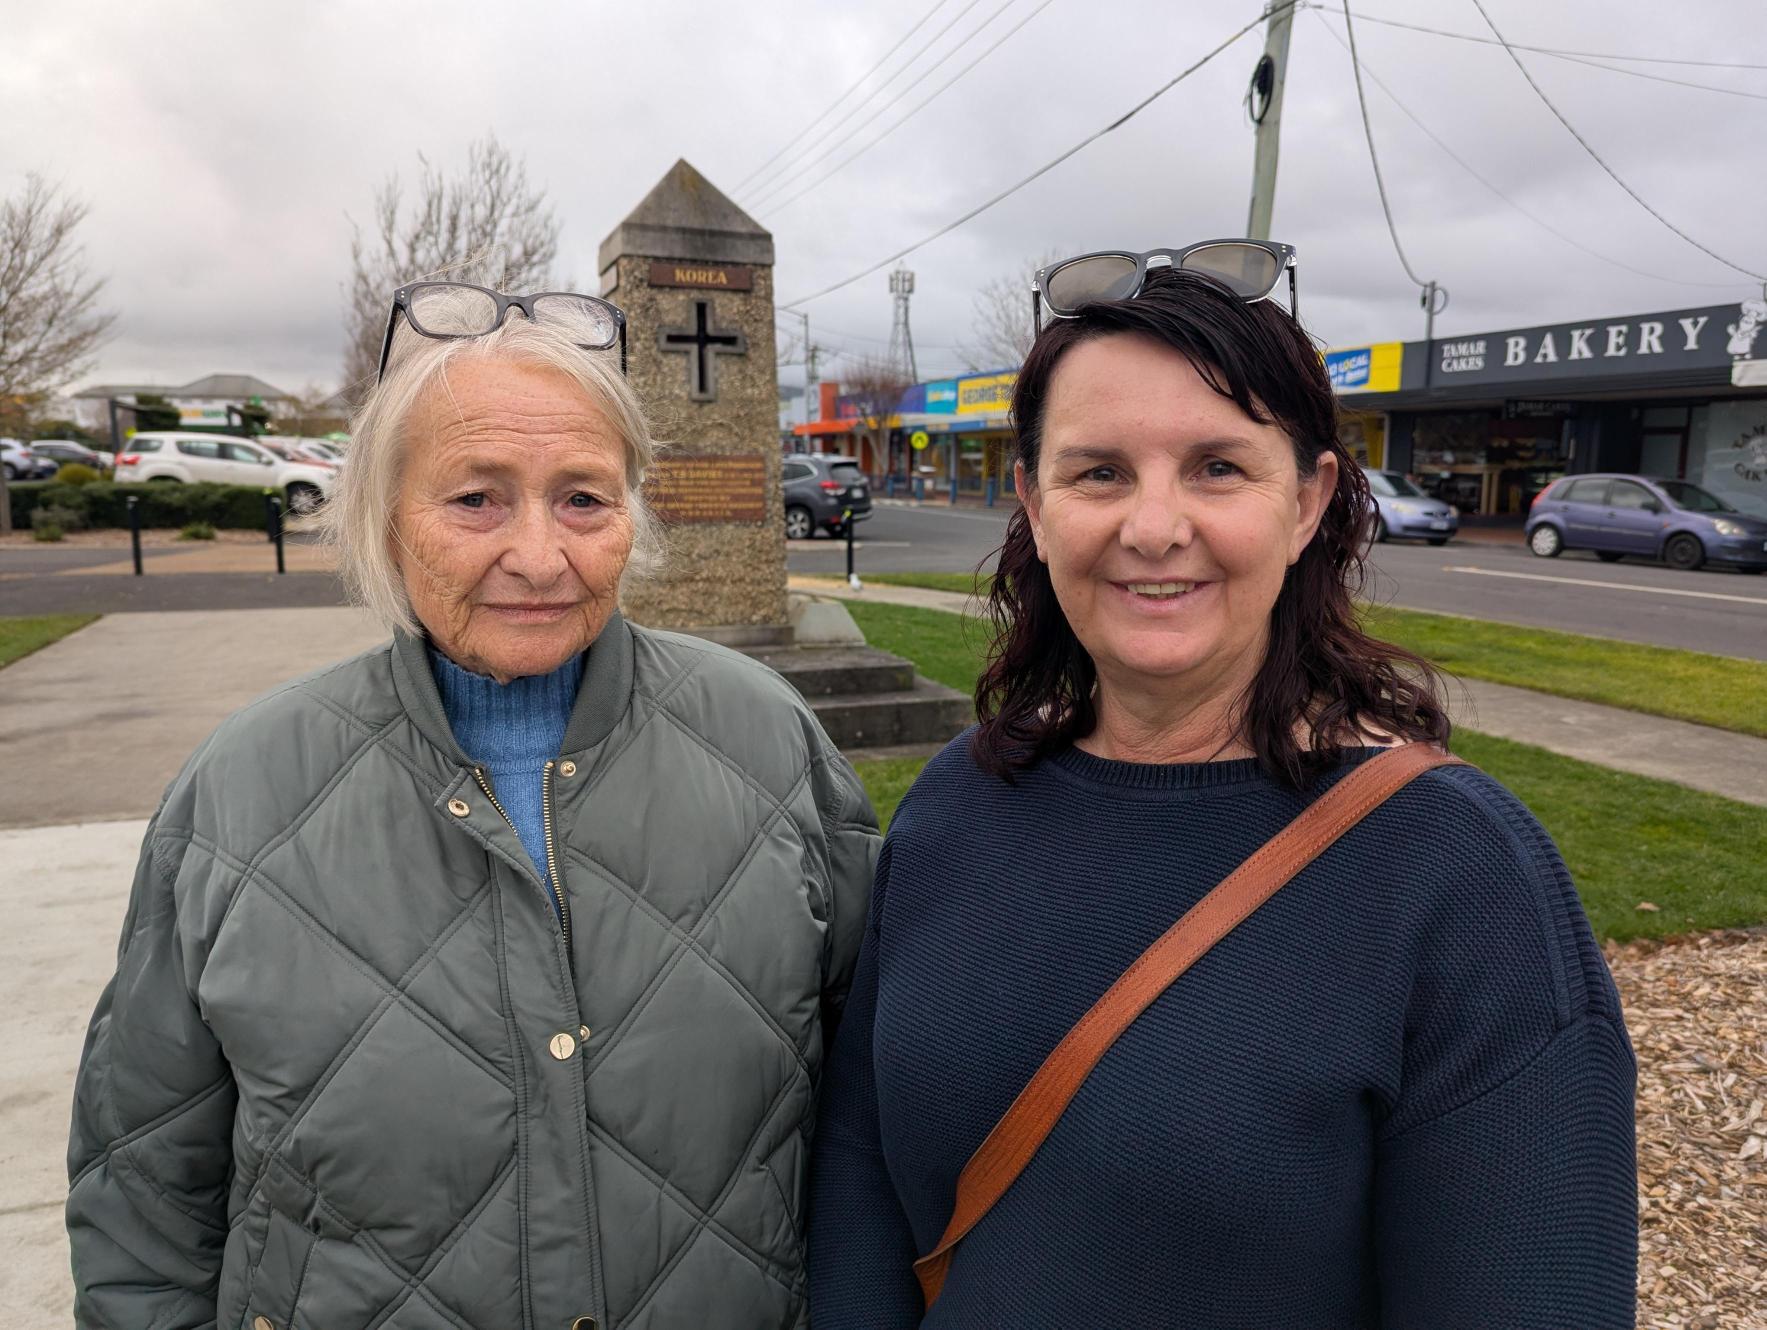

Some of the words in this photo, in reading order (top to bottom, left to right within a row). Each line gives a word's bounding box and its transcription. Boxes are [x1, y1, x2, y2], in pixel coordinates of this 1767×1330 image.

[674, 268, 728, 285] KOREA
[1441, 340, 1487, 358] TAMAR
[1504, 316, 1709, 367] BAKERY
[1441, 355, 1485, 373] CAKES
